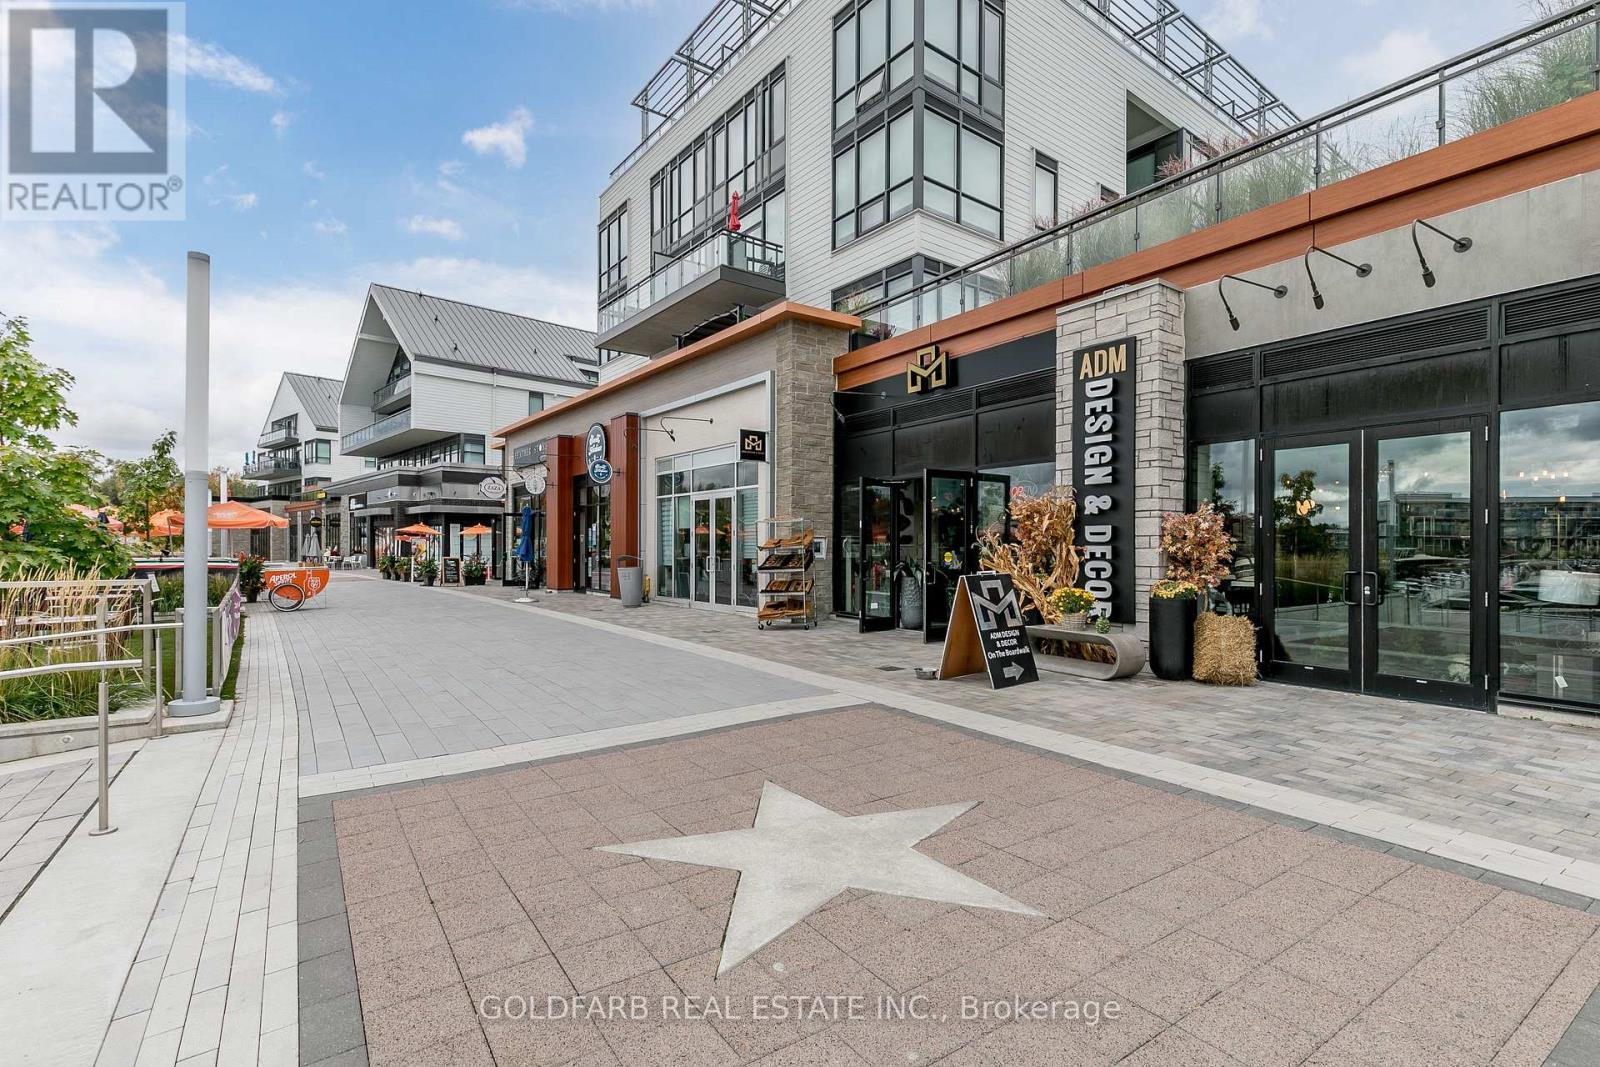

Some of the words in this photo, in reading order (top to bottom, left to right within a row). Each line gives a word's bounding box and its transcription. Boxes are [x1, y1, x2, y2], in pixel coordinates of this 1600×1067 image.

[1079, 344, 1127, 380] ADM
[1084, 377, 1114, 486] DESIGN
[1084, 494, 1112, 515] &
[990, 631, 1002, 640] ADM
[1002, 629, 1020, 638] DESIGN
[1001, 638, 1018, 647] DECOR
[987, 651, 996, 659] On
[995, 649, 1006, 658] The
